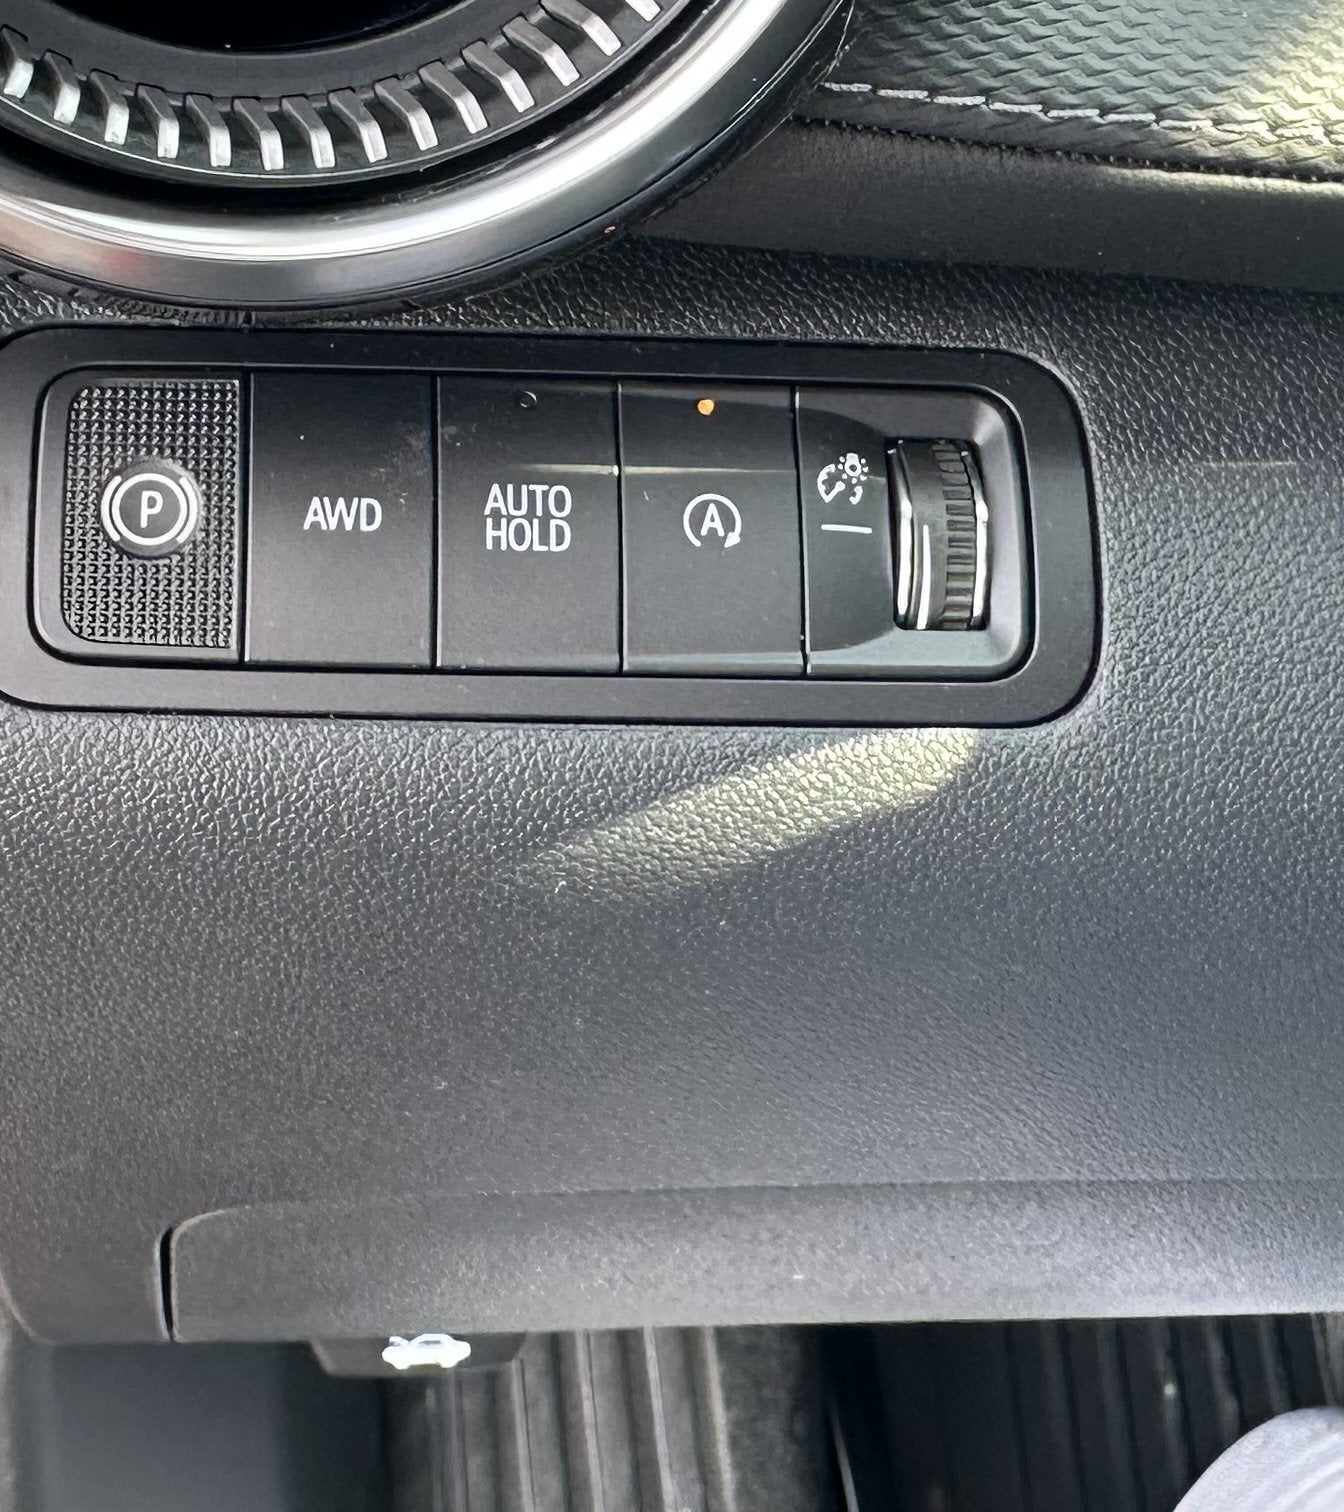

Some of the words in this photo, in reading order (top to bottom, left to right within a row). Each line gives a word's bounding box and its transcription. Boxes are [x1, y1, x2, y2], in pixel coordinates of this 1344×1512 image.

[303, 497, 382, 532] AWD
[484, 484, 571, 518] AUTO
[486, 519, 571, 552] HOLD
